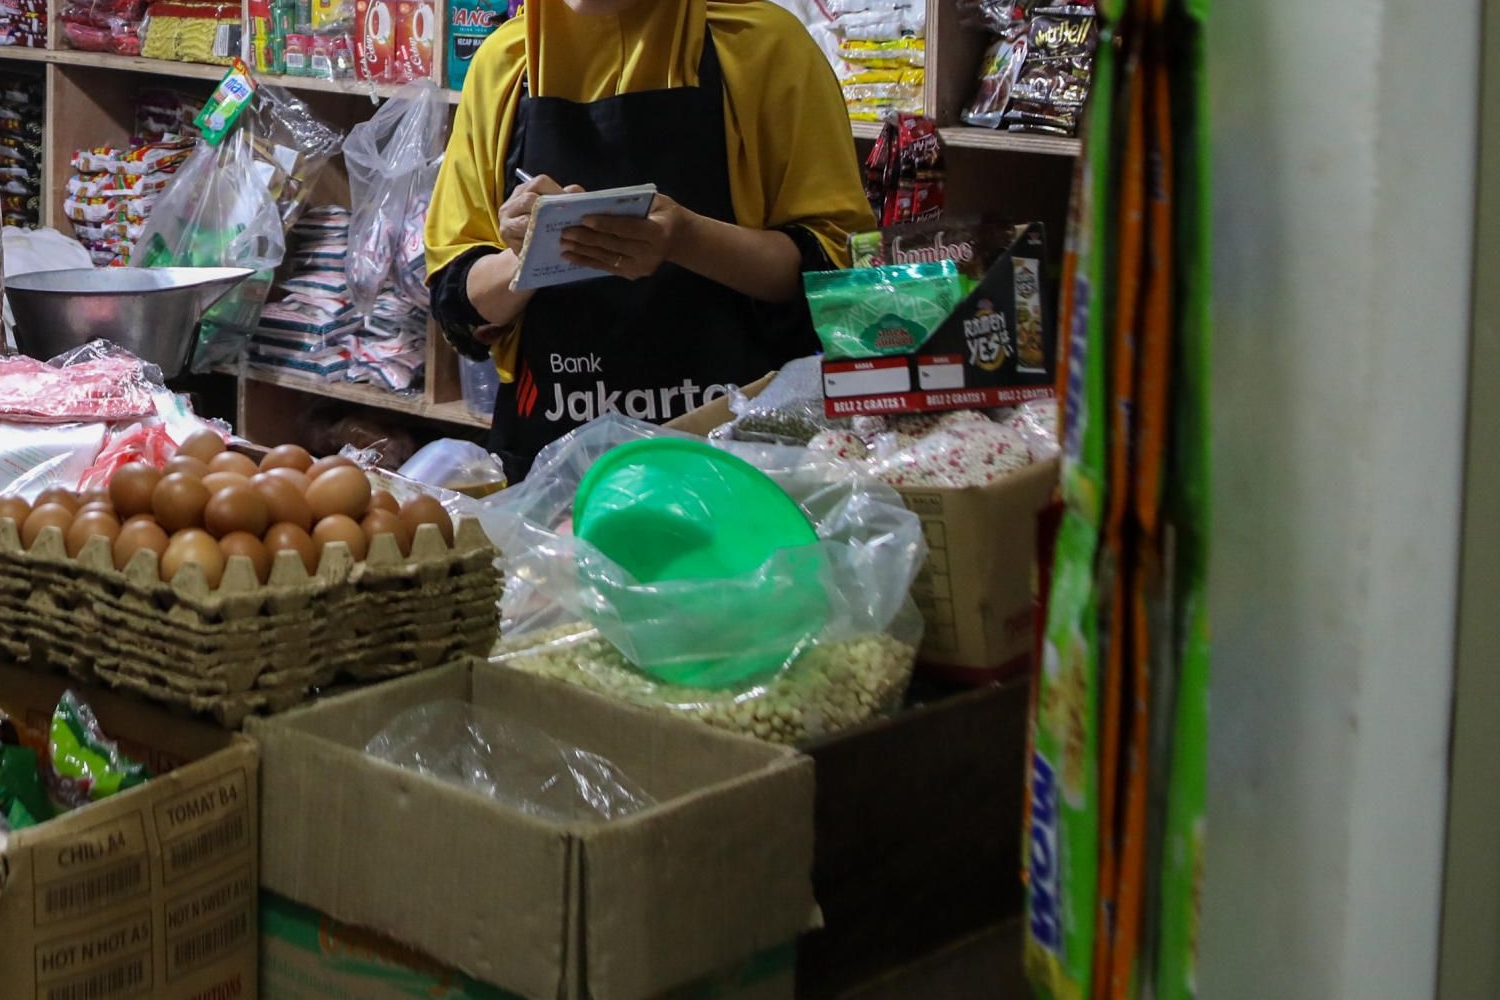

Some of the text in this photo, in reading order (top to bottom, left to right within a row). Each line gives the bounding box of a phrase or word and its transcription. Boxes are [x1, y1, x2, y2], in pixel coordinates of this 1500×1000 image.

[964, 313, 1006, 338] RAMEN
[550, 352, 602, 373] Bank
[165, 794, 218, 827] TOMAT
[41, 950, 75, 973] HOT
[97, 932, 127, 957] HOT
